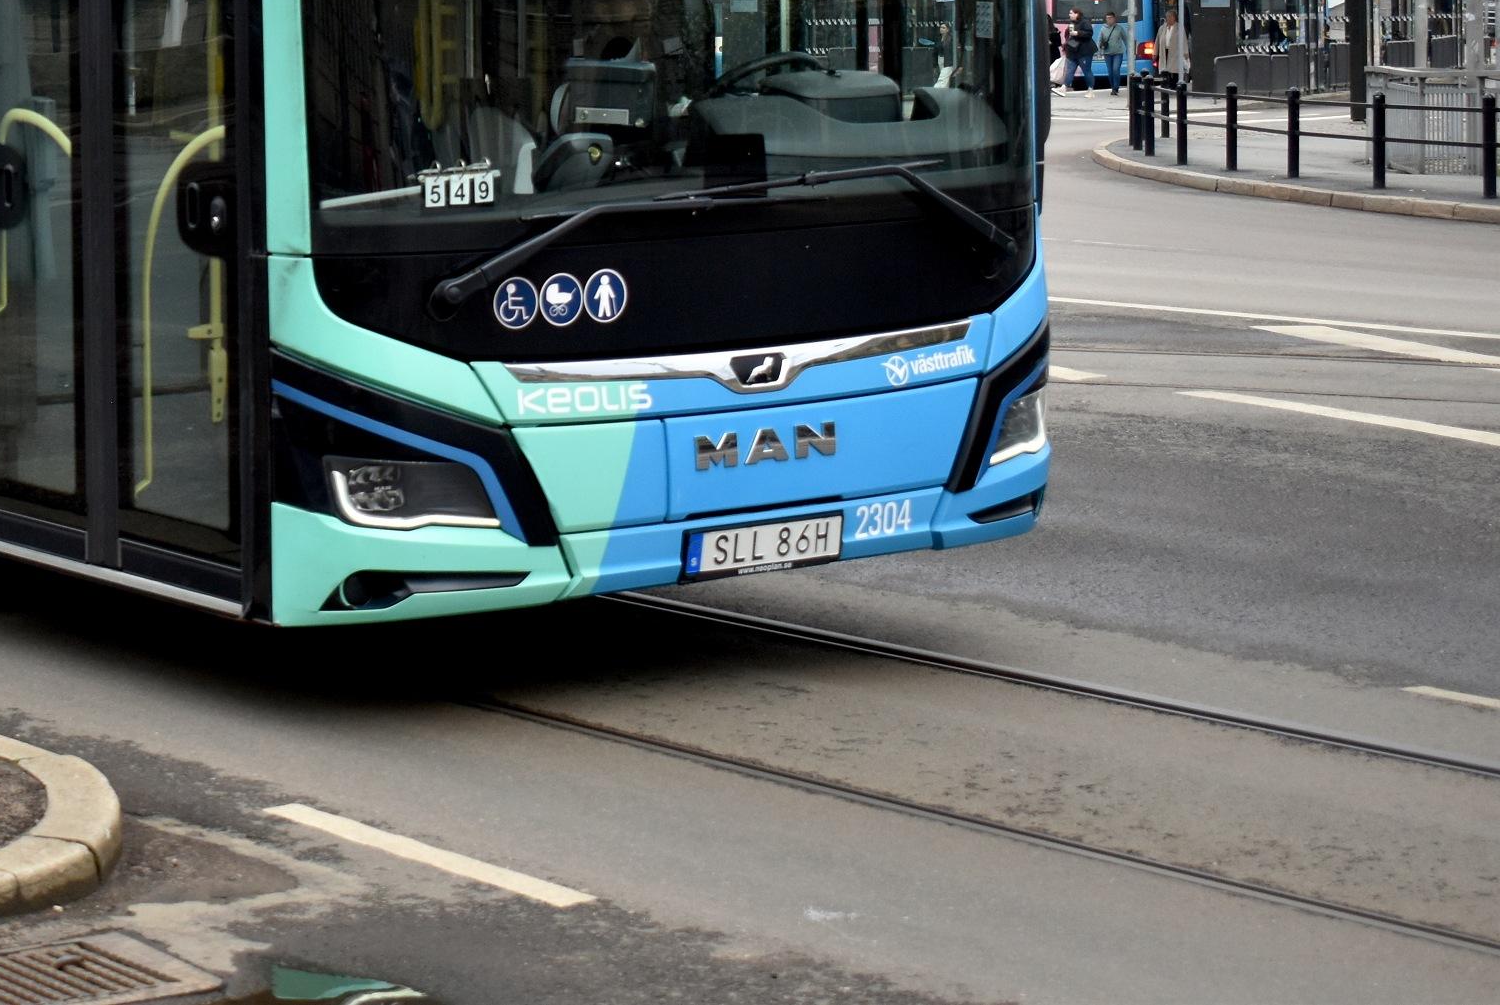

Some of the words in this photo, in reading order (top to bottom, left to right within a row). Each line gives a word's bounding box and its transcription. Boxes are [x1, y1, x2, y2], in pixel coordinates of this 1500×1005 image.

[910, 344, 976, 375] västtrafik
[694, 420, 837, 471] MAN
[855, 499, 912, 541] 2304
[713, 529, 764, 565] SLL
[776, 521, 830, 557] 86H
[737, 561, 793, 575] www.neoplan.se
